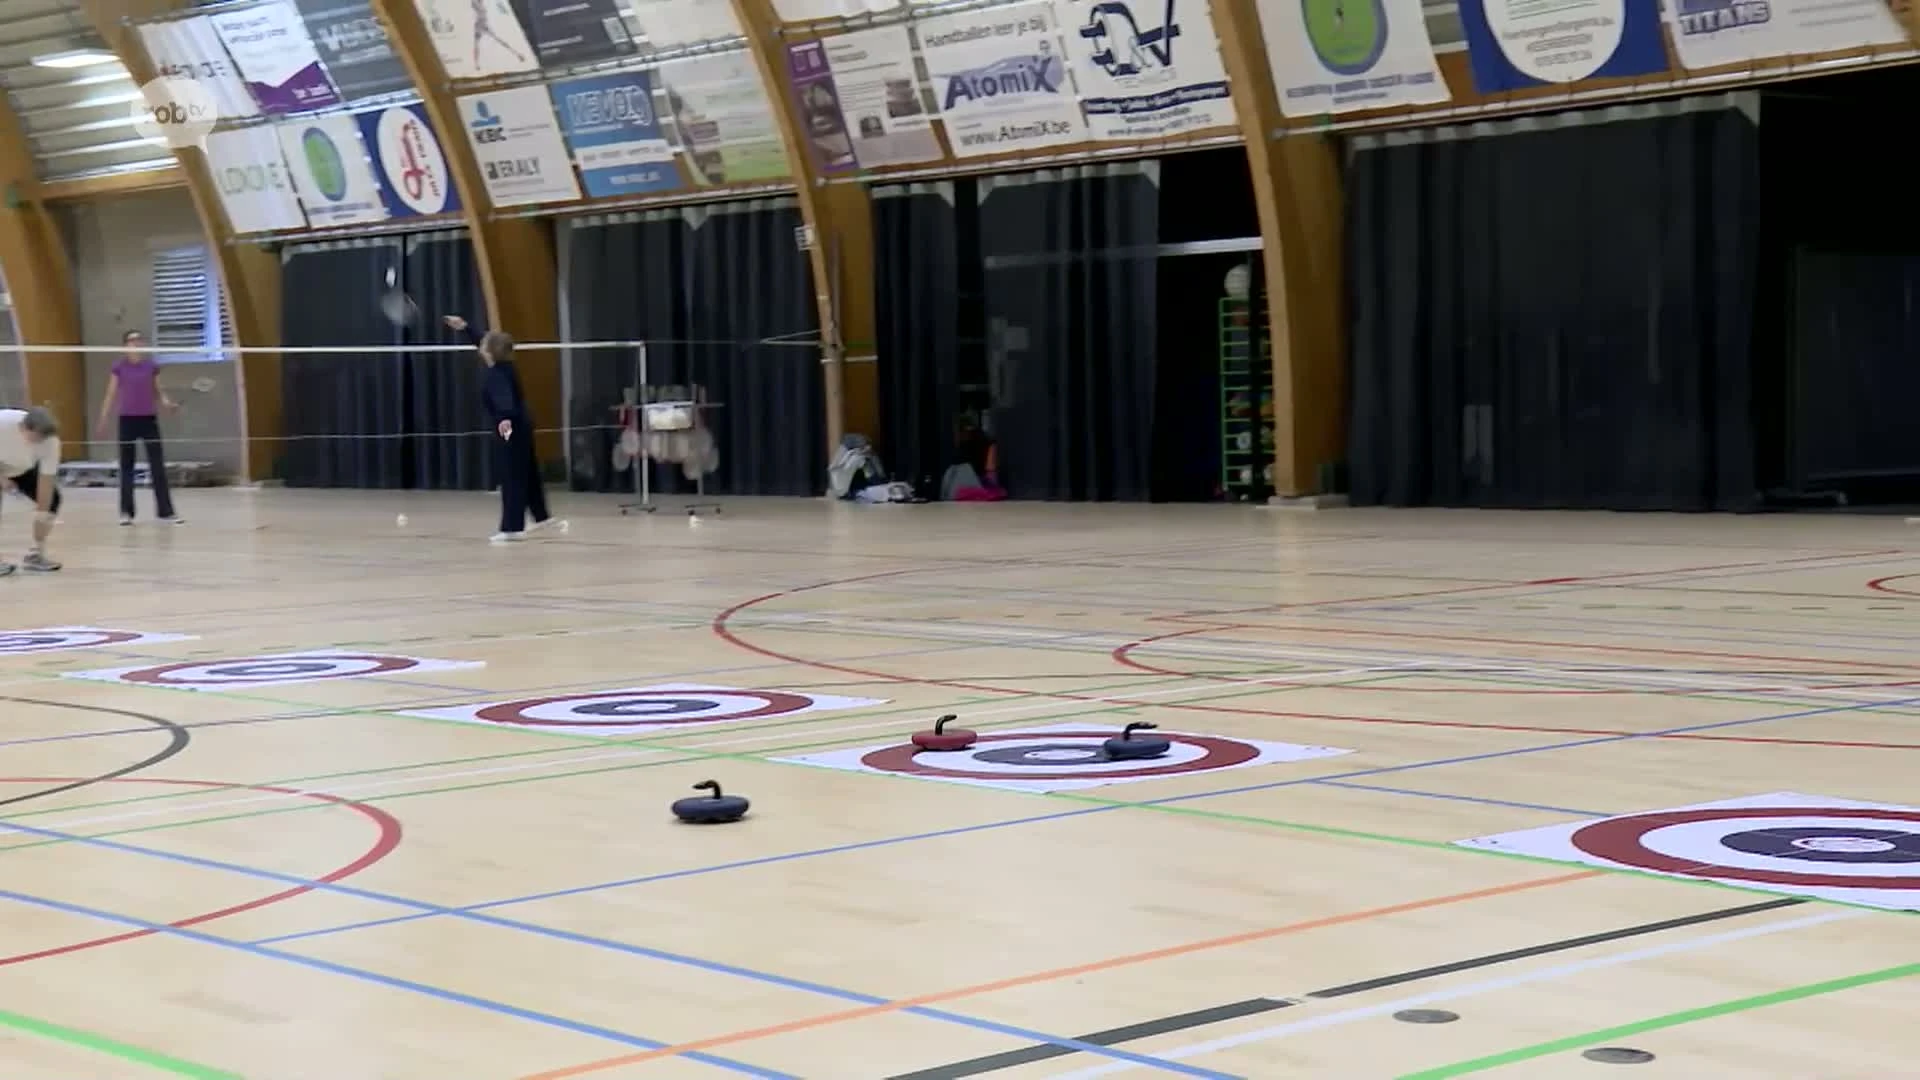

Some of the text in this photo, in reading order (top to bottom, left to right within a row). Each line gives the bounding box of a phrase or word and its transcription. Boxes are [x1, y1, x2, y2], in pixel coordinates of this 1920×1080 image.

[1680, 2, 1771, 36] TITANS
[944, 54, 1059, 110] AtomiX
[474, 127, 507, 144] KBC
